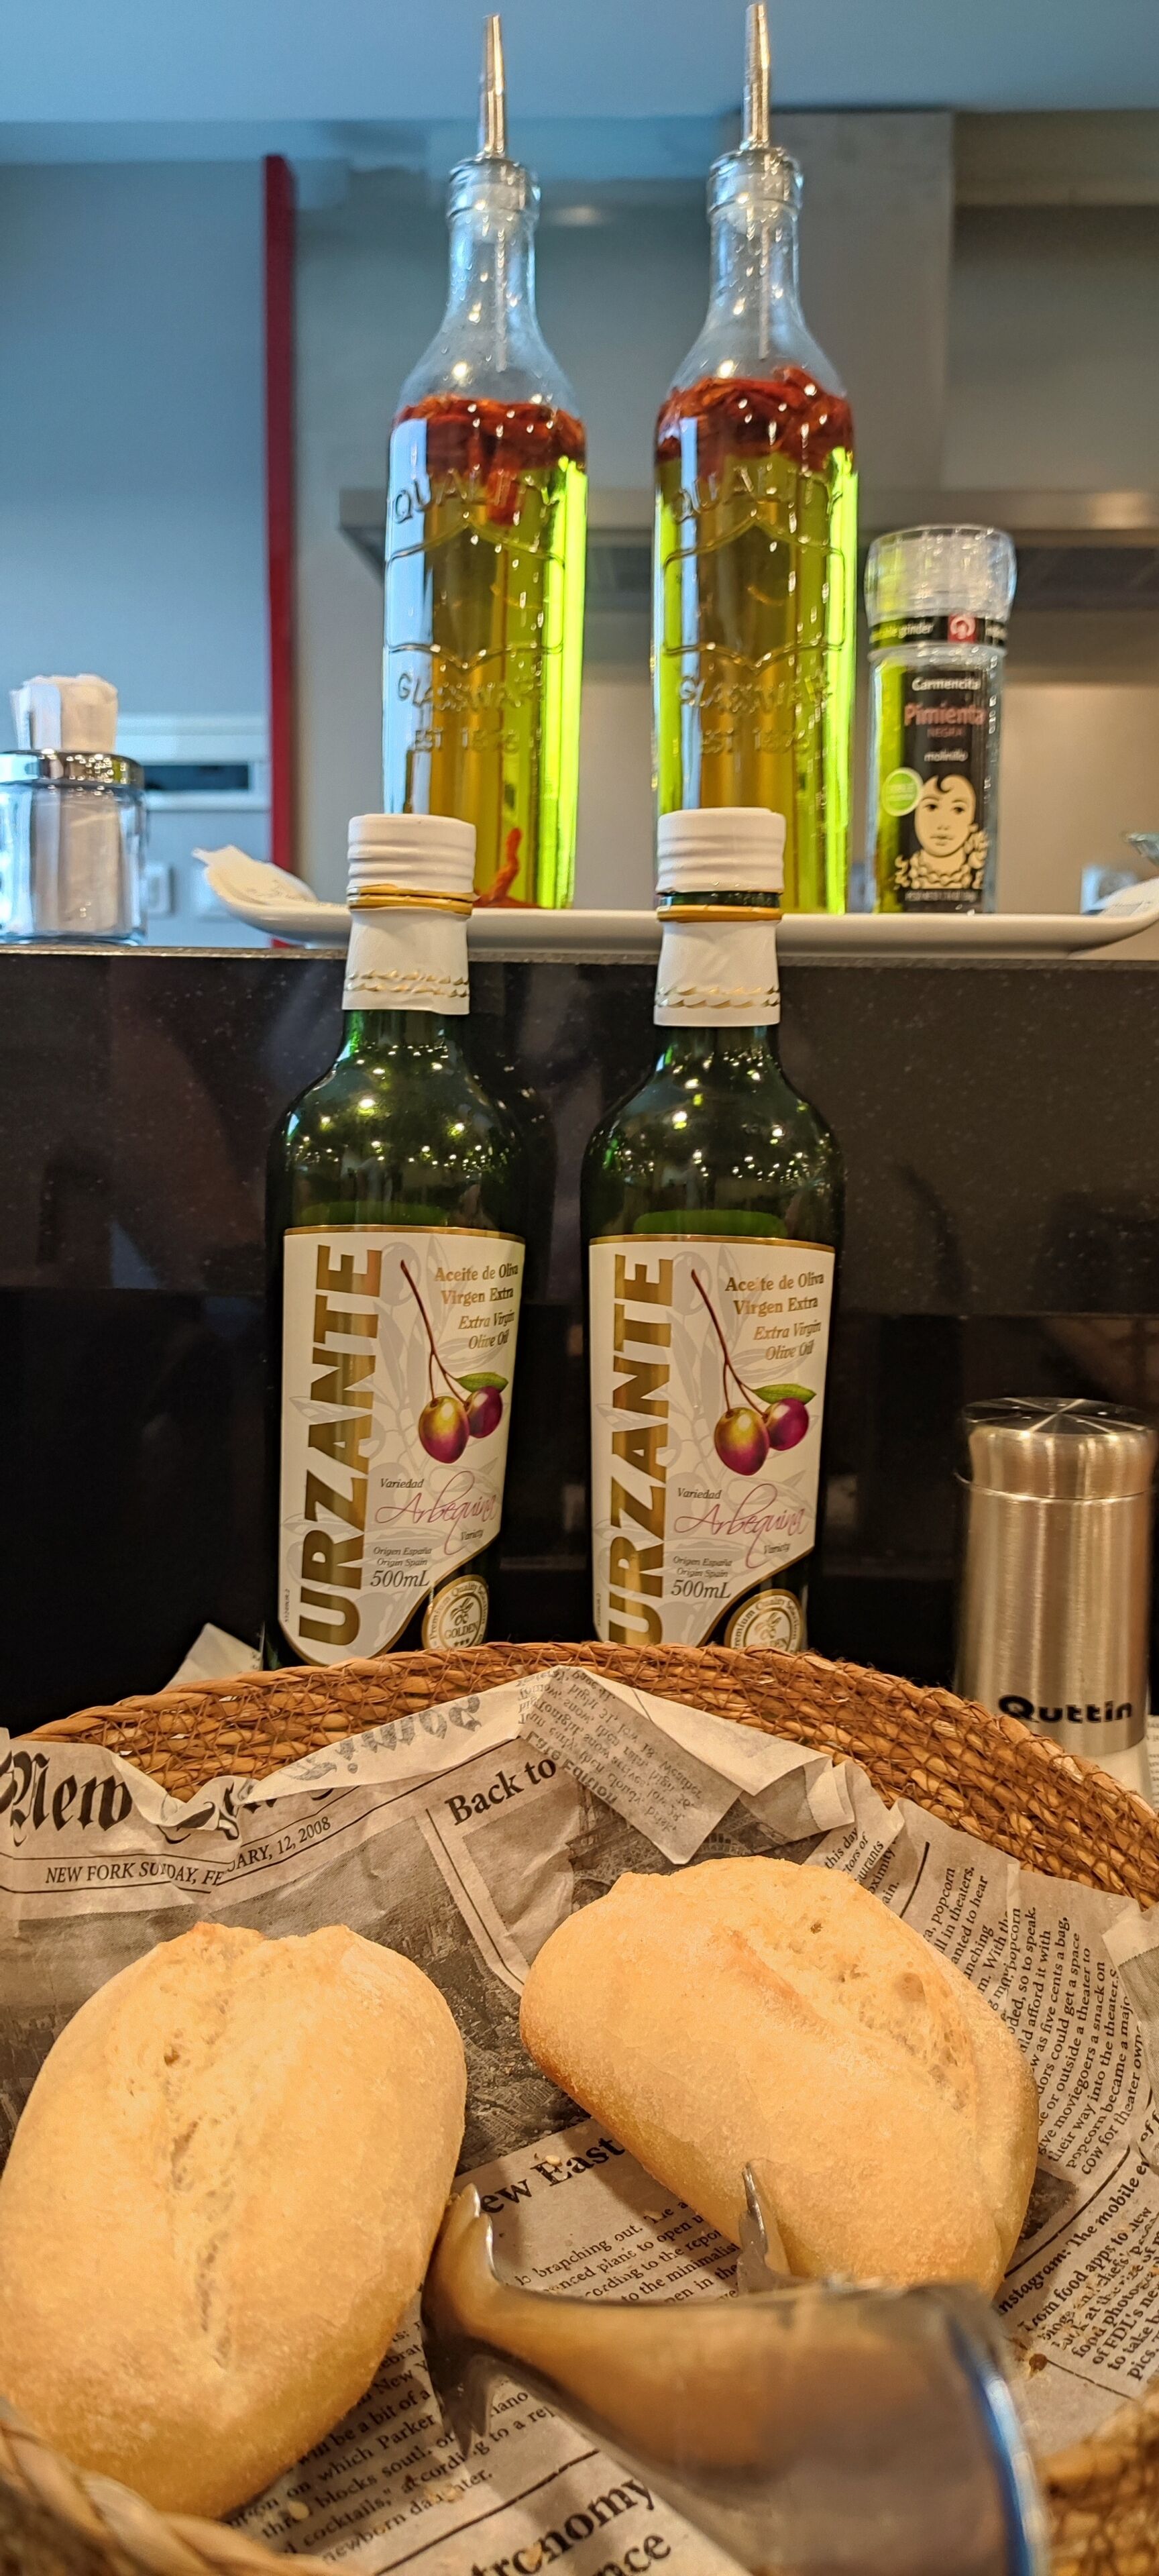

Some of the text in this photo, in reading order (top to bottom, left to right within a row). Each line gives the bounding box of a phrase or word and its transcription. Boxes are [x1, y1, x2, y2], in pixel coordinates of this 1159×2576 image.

[912, 677, 981, 691] Carmencita
[903, 702, 986, 726] Pimienta
[435, 1263, 518, 1281] Aceite de Oliva
[724, 1272, 824, 1291] Aceite de Oliva
[441, 1287, 514, 1307] Virgen Extra
[733, 1296, 818, 1317] Virgen Extra
[458, 1309, 515, 1330] Extra Virgin
[753, 1320, 822, 1340] Extra Virgin
[469, 1329, 510, 1350] Olive Oil
[765, 1340, 814, 1360] Olive Oil
[299, 1244, 382, 1646] URZANTE
[608, 1254, 673, 1644] URZANTE
[380, 1478, 425, 1489] Variedad
[677, 1487, 722, 1499] Variedad
[376, 1470, 497, 1555] Arbequina
[674, 1483, 806, 1568] Arbequina
[374, 1546, 433, 1556] Origen España
[461, 1529, 484, 1541] Variety
[763, 1544, 791, 1554] Variety
[377, 1558, 428, 1568] Origin Spain
[673, 1556, 733, 1567] Origen España
[677, 1568, 728, 1578] Origin Spain
[370, 1570, 430, 1588] 500mL
[451, 1582, 478, 1597] Quality
[671, 1579, 732, 1599] 500mL
[445, 1620, 479, 1639] GOLDEN
[998, 1695, 1132, 1723] Quttin
[444, 1754, 557, 1826] Back to
[46, 1867, 82, 1884] NEW
[87, 1862, 135, 1881] FORK
[277, 1839, 296, 1856] 12,
[297, 1816, 332, 1845] 2008
[824, 1827, 859, 1869] this day
[859, 1831, 869, 1849] of
[931, 1867, 956, 1925] popcorn
[941, 1866, 975, 1939] in theaters.
[969, 1876, 988, 1909] hear
[966, 1910, 977, 1925] to
[983, 1935, 1007, 1971] With
[1008, 1908, 1021, 1972] popcorn
[1018, 1907, 1036, 1993] so to speak.
[1027, 1930, 1051, 2027] afford it with
[1036, 1917, 1070, 2052] as five cents a bag,
[1051, 1933, 1081, 2060] could get a space
[1046, 1948, 1091, 2110] or outside a theater to
[1054, 1962, 1105, 2129] moviegoers a snack on
[1048, 2041, 1113, 2162] their way into the
[1066, 2041, 1128, 2169] popcorn became a
[1081, 2072, 1140, 2175] cow for theater
[1140, 2119, 1154, 2142] of
[531, 2137, 625, 2187] East
[532, 2222, 643, 2278] branching out.
[637, 2219, 694, 2252] to open
[999, 2248, 1072, 2313] nstagram:
[1096, 2177, 1140, 2226] mobile
[641, 2247, 685, 2271] to the
[1053, 2270, 1089, 2303] food
[1085, 2245, 1116, 2273] apps
[1111, 2233, 1128, 2245] to
[639, 2279, 666, 2296] the
[696, 2263, 739, 2292] in the
[1085, 2306, 1101, 2320] at
[1093, 2347, 1110, 2365] of
[1103, 2308, 1144, 2349] FDL's
[1107, 2356, 1126, 2371] to
[1123, 2326, 1153, 2353] take
[373, 2369, 415, 2395] New
[329, 2389, 431, 2447] be a bit of a
[286, 2414, 437, 2499] on which Parker
[302, 2420, 527, 2547] cocktails," to a
[315, 2474, 378, 2510] blocks
[321, 2512, 406, 2563] newborn
